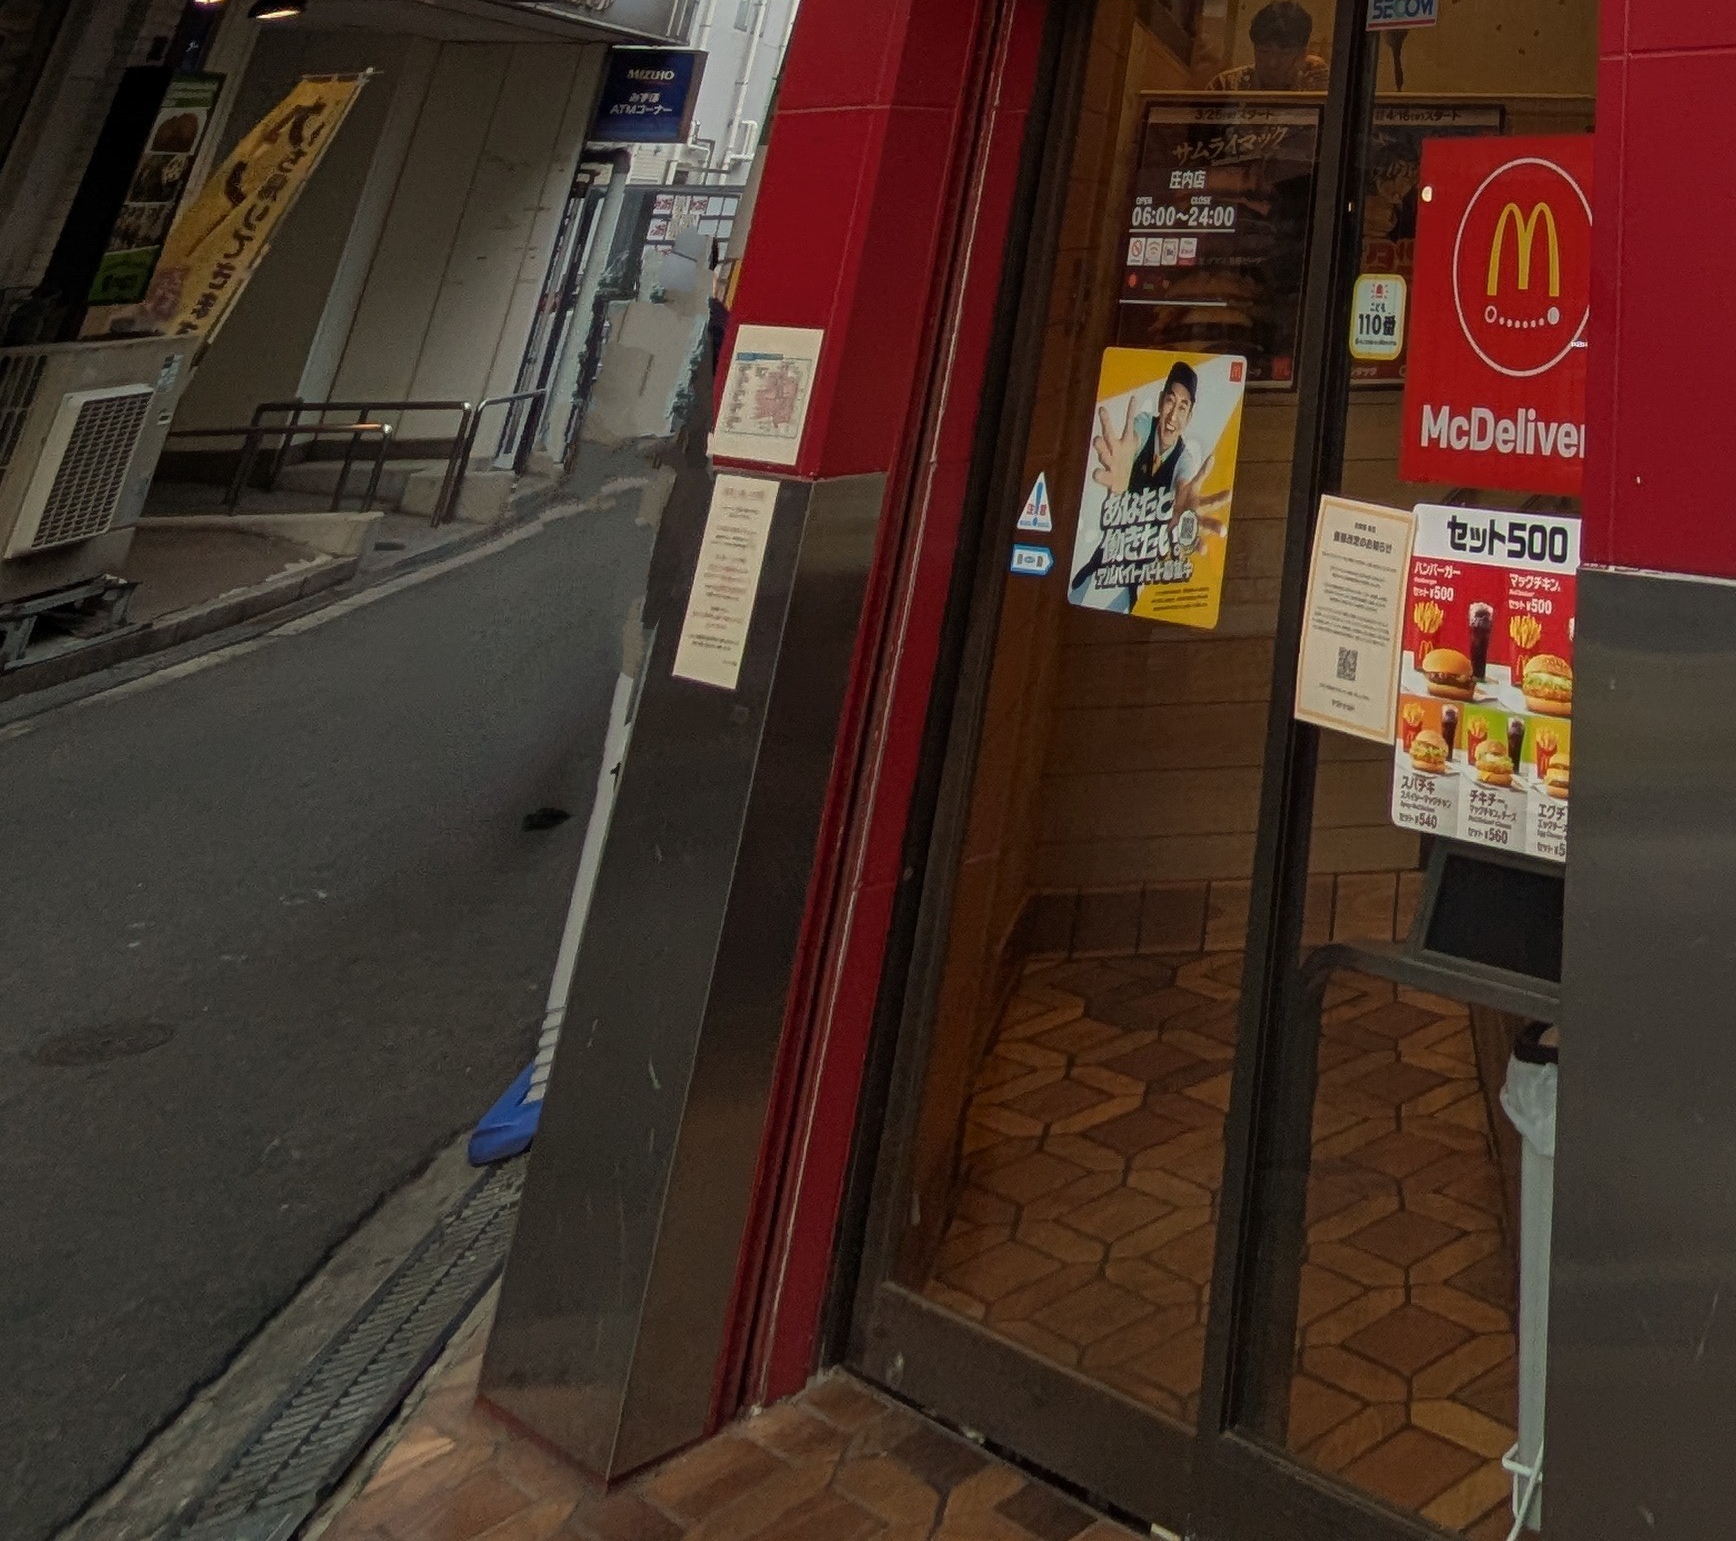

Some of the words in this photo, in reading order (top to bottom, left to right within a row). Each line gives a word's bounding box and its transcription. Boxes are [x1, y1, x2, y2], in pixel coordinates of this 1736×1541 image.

[627, 69, 675, 80] MIZUHO
[610, 104, 672, 115] ATMコーナー
[1172, 127, 1288, 166] サムライマック
[1169, 170, 1206, 189] 庄内店
[1359, 314, 1396, 336] 110番
[1103, 486, 1176, 525] あなたと
[1447, 515, 1568, 564] セット500
[1415, 562, 1461, 578] ハンバーガー
[1401, 775, 1436, 793] スパチキ
